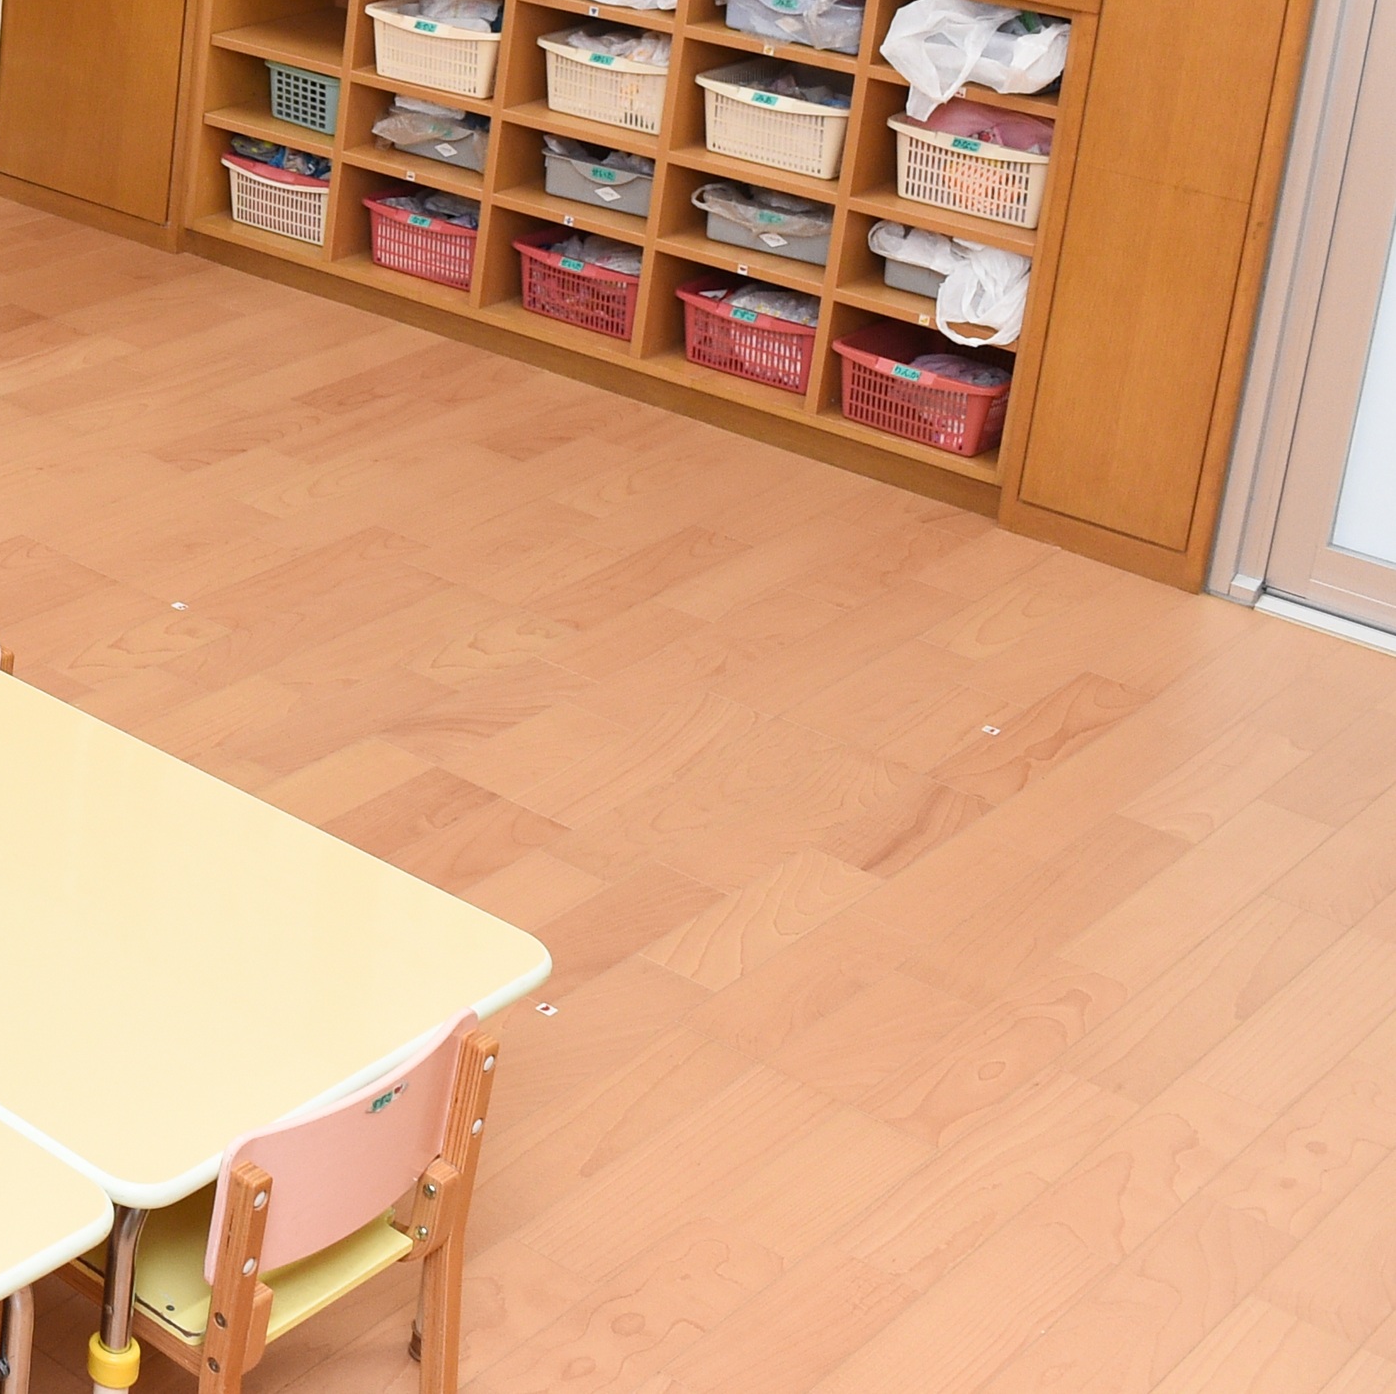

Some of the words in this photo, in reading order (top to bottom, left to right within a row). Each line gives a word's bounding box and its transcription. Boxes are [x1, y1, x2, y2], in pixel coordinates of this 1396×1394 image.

[953, 137, 979, 151] ひなこ
[894, 364, 920, 380] りんか
